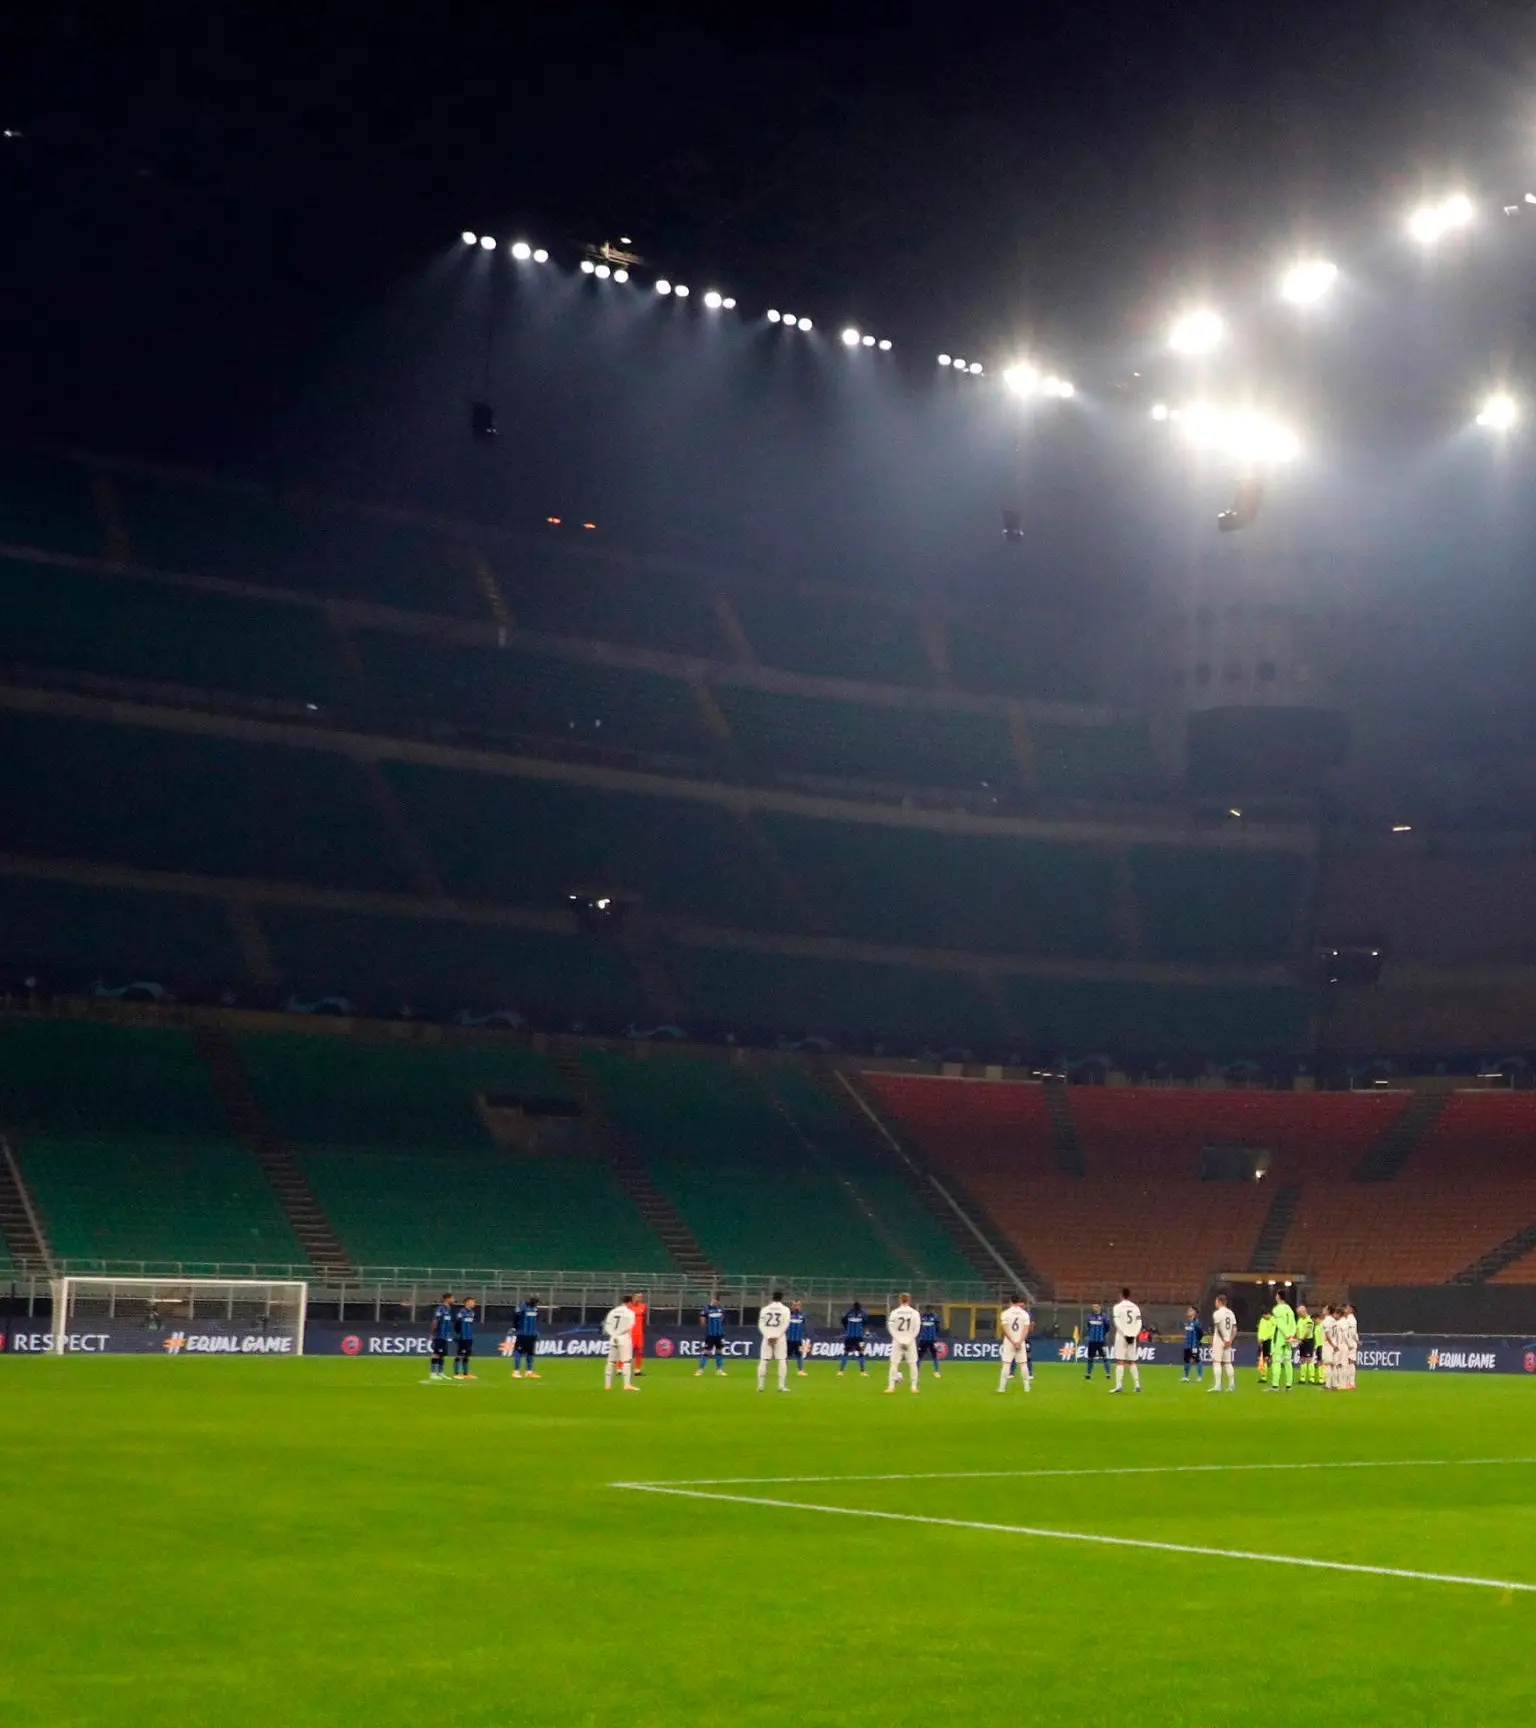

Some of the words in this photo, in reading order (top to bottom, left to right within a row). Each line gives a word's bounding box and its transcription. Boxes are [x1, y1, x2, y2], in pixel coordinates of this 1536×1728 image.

[613, 1314, 622, 1331] 7
[764, 1312, 782, 1327] 23
[897, 1316, 912, 1332] 21
[1011, 1317, 1020, 1332] 6
[1126, 1310, 1133, 1325] 5
[1225, 1316, 1231, 1330] 8
[1286, 1313, 1290, 1324] 1
[13, 1333, 110, 1351] RESPECT
[369, 1336, 435, 1353] RESPEC
[1357, 1351, 1401, 1367] RESPECT
